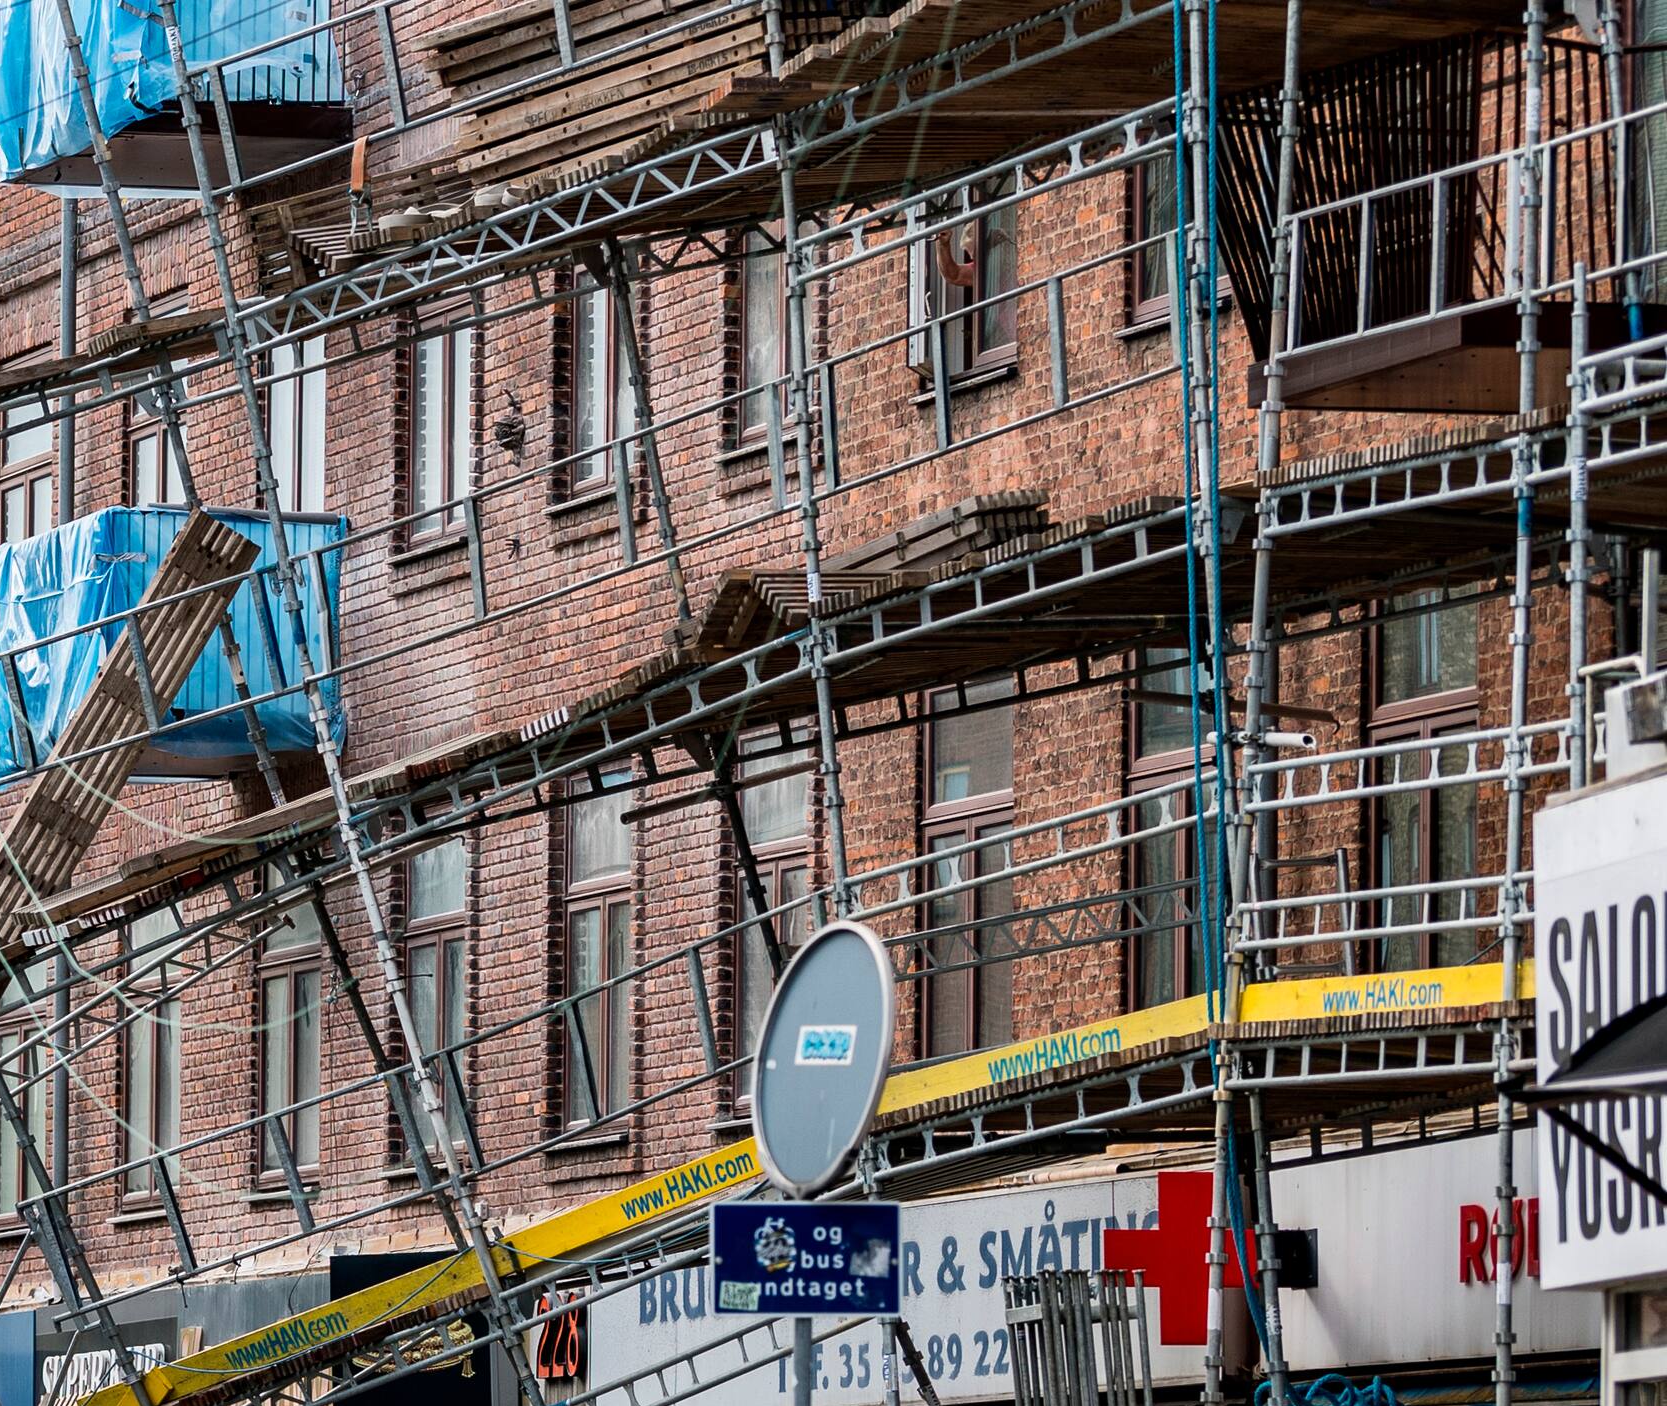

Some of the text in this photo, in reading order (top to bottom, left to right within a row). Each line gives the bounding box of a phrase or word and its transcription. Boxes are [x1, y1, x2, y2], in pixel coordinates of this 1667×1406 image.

[1323, 978, 1443, 1012] www.HAKI.com
[1549, 893, 1667, 1069] SALO
[620, 1152, 755, 1221] www.HAKI.com
[812, 1226, 843, 1245] og
[936, 1235, 967, 1296] &
[536, 1292, 579, 1379] 228
[839, 1343, 871, 1389] 35
[927, 1332, 963, 1381] 89
[973, 1328, 1010, 1377] 22
